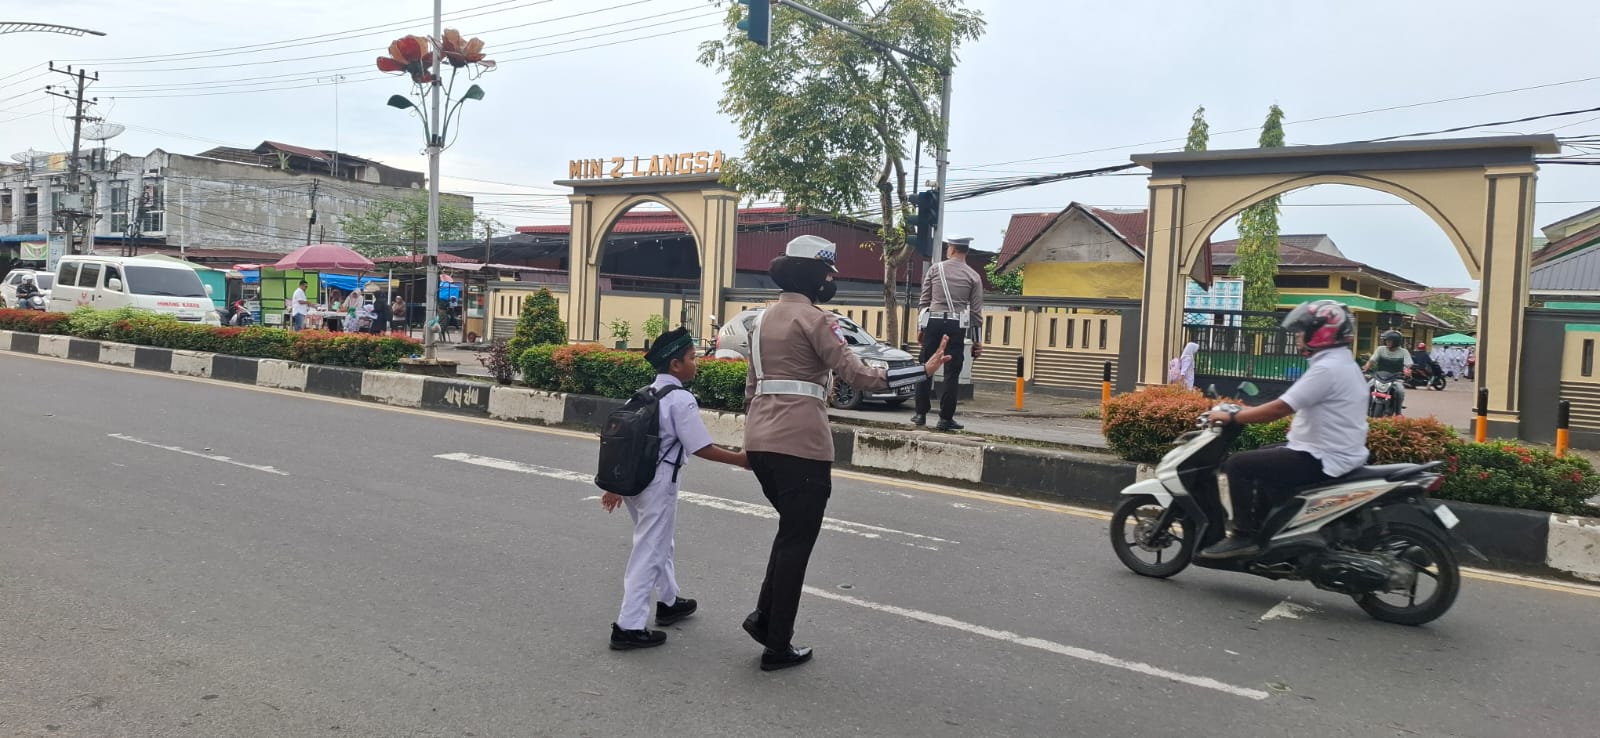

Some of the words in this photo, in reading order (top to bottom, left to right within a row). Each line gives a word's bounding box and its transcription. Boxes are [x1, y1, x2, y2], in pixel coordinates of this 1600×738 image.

[569, 158, 603, 179] MIN
[610, 156, 624, 178] 2
[632, 150, 724, 176] LANGSA
